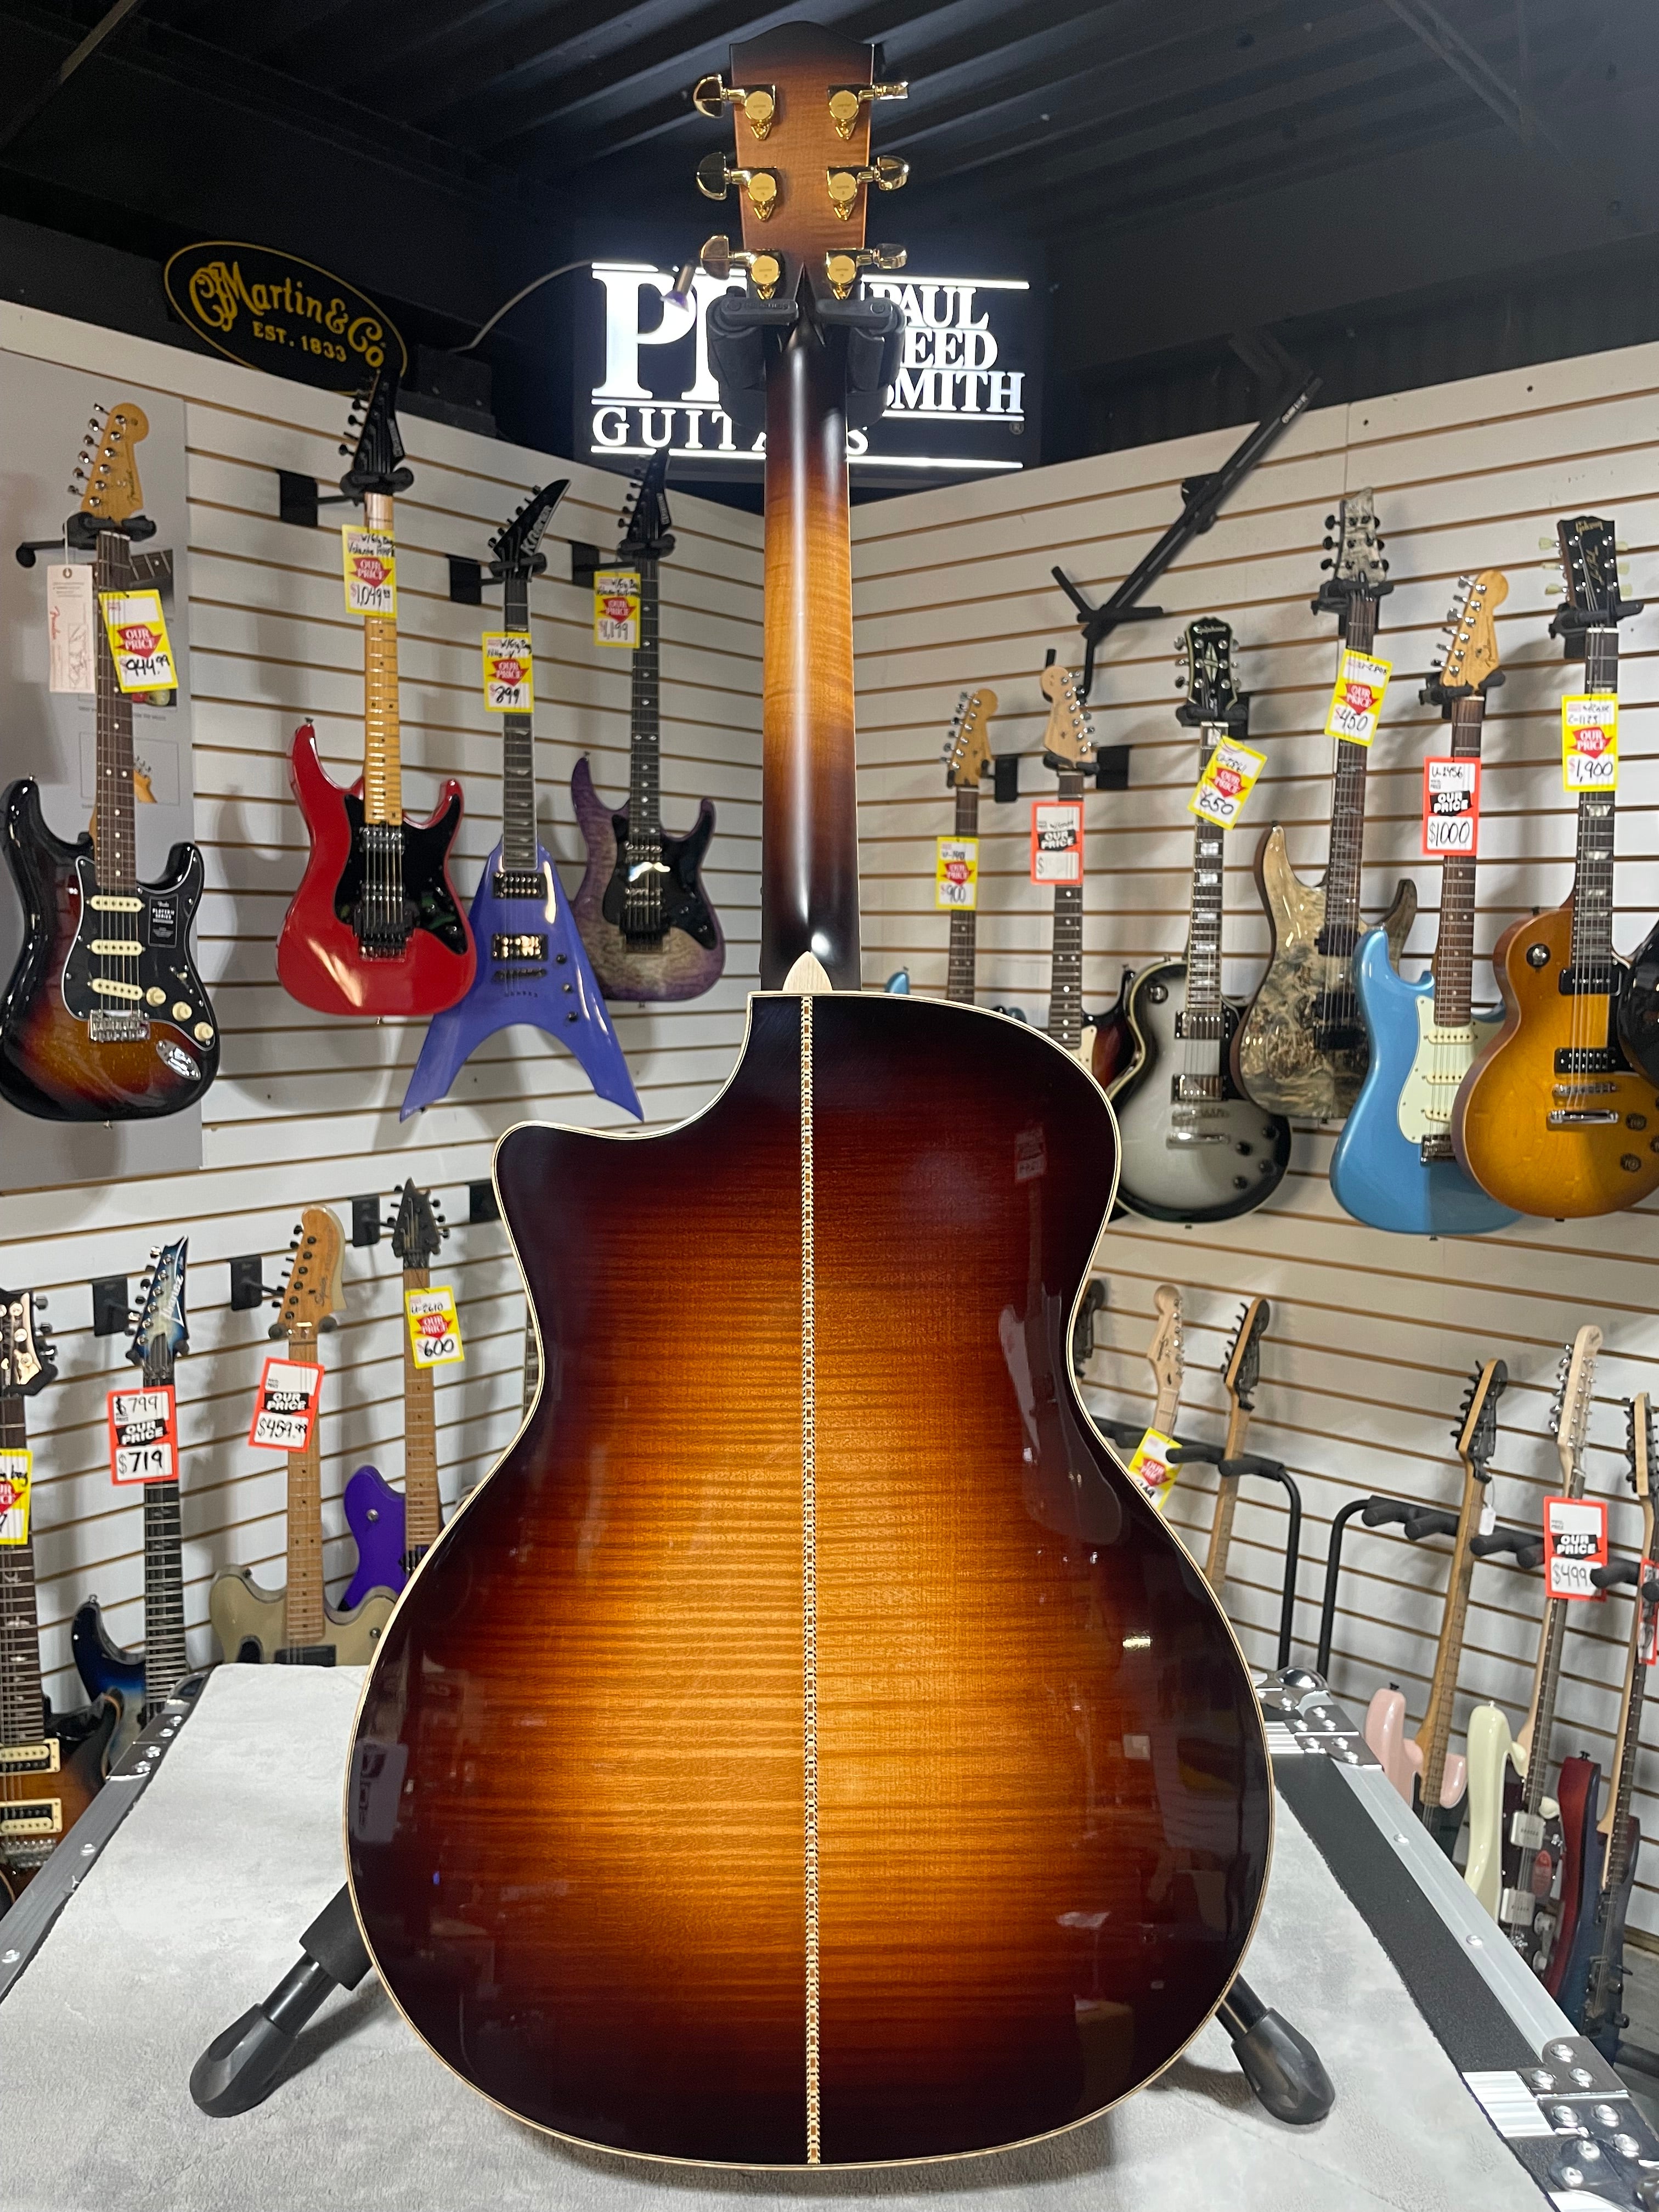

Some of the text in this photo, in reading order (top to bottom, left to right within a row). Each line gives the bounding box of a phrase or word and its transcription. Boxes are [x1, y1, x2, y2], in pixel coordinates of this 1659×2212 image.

[252, 320, 347, 363] EST. 1833
[900, 328, 998, 370] EED
[887, 368, 1025, 414] MITH
[591, 406, 869, 455] GUITS
[360, 560, 382, 570] OUR
[357, 568, 385, 580] PRICE
[608, 600, 628, 608] OUR
[606, 607, 630, 616] PRICE
[126, 627, 150, 640] OUR
[125, 637, 155, 651] PRICE
[498, 662, 519, 671] OUR
[496, 670, 522, 679] PRICE
[1351, 685, 1372, 698] OUR
[1346, 693, 1372, 708] PRICE
[1580, 730, 1603, 741] OUR
[1577, 740, 1606, 752] PRICE
[1569, 758, 1613, 783] $1,900
[1220, 770, 1241, 785] OUR
[1214, 776, 1242, 794] PRICE
[1437, 792, 1463, 804] OUR
[1434, 799, 1469, 814] PRICE
[1044, 830, 1069, 841] OUR
[1429, 821, 1470, 847] $1000
[1041, 837, 1075, 850] PRICE
[949, 864, 965, 872] OUR
[947, 871, 969, 880] PRICE
[424, 1315, 443, 1326] OUR
[421, 1323, 448, 1334] PRICE
[273, 1392, 301, 1402] OUR
[267, 1400, 307, 1410] PRICE
[125, 1419, 156, 1435] OUR
[121, 1427, 164, 1445] PRICE
[119, 1449, 163, 1475] $719
[1560, 1534, 1589, 1545] OUR
[1556, 1543, 1596, 1555] PRICE
